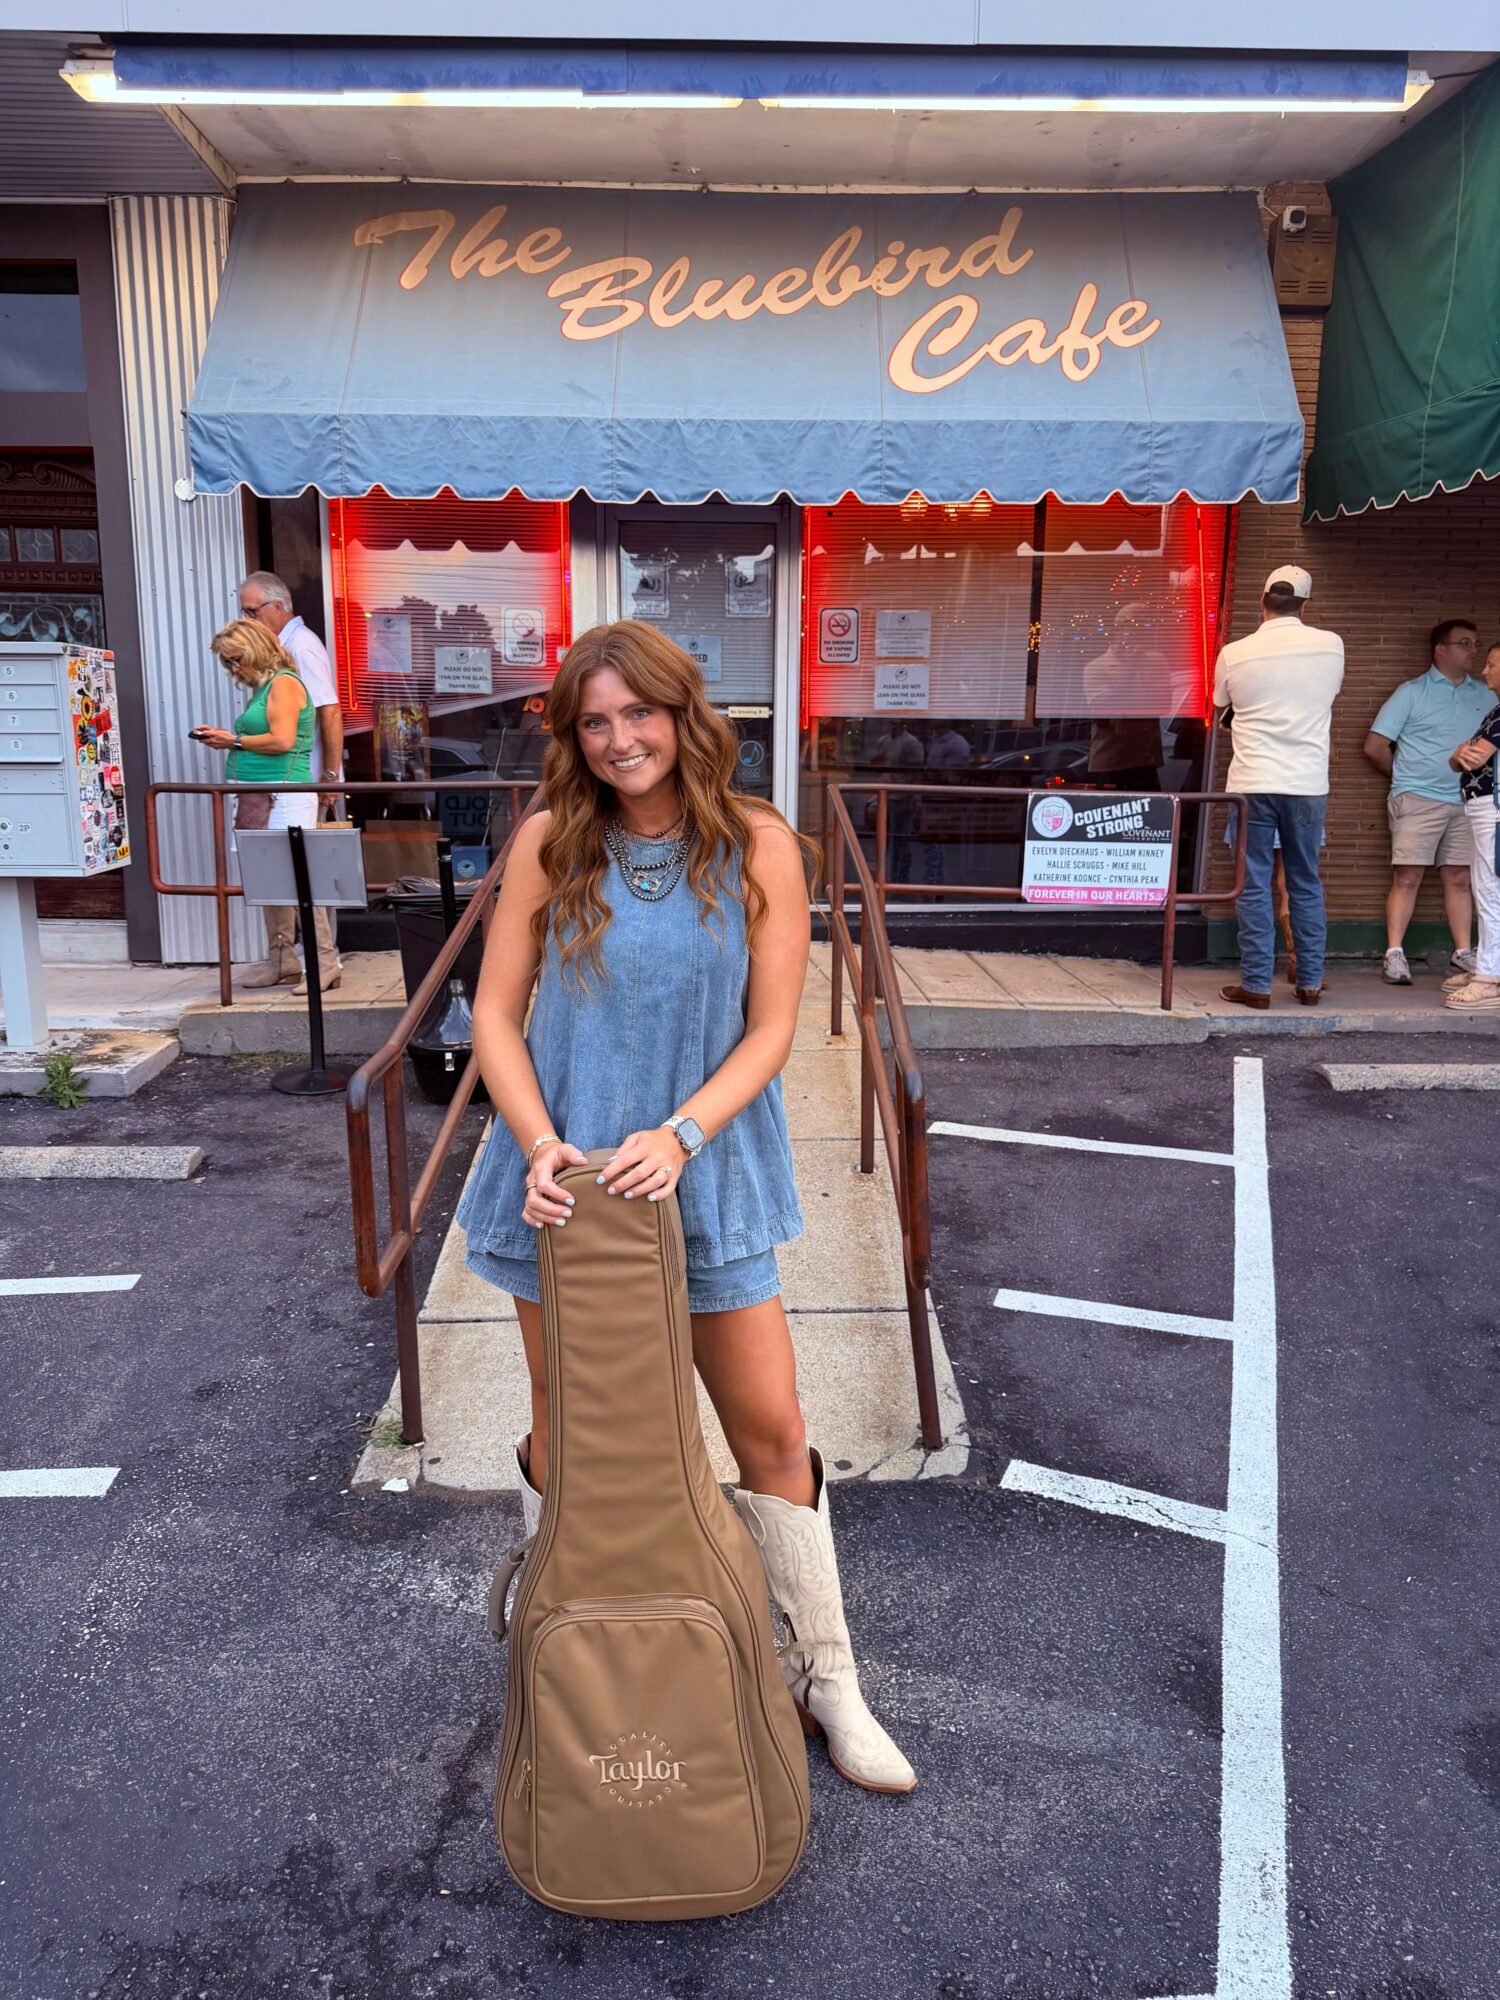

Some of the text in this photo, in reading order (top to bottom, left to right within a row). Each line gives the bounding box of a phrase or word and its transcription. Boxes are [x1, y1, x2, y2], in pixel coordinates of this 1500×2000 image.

[355, 204, 571, 290] The
[547, 206, 1034, 341] Bluebird
[887, 283, 1161, 394] Cafe
[1074, 798, 1151, 826] COVENANT
[1086, 815, 1144, 839] STRONG
[1032, 846, 1057, 856] EVELYN
[1060, 847, 1098, 856] DIECKHAUS
[1106, 848, 1136, 857] WILLIAM
[1138, 849, 1164, 858] KINNEY
[1047, 861, 1071, 869] HALLIE
[1073, 861, 1104, 870] SCRUGGS
[1112, 862, 1129, 870] MIKE
[1132, 862, 1147, 871] HILL
[1033, 874, 1071, 882] KATHERINE
[1074, 874, 1101, 883] KOONCE
[1109, 875, 1139, 884] CYNTHIA
[1141, 875, 1159, 884] PEAK
[1029, 889, 1074, 899] FOREVER
[1076, 890, 1087, 899] IN
[1091, 890, 1113, 900] OUR
[610, 1731, 673, 1756] QUALITY
[588, 1750, 687, 1791] Taylor
[609, 1787, 672, 1808] GUITARS
